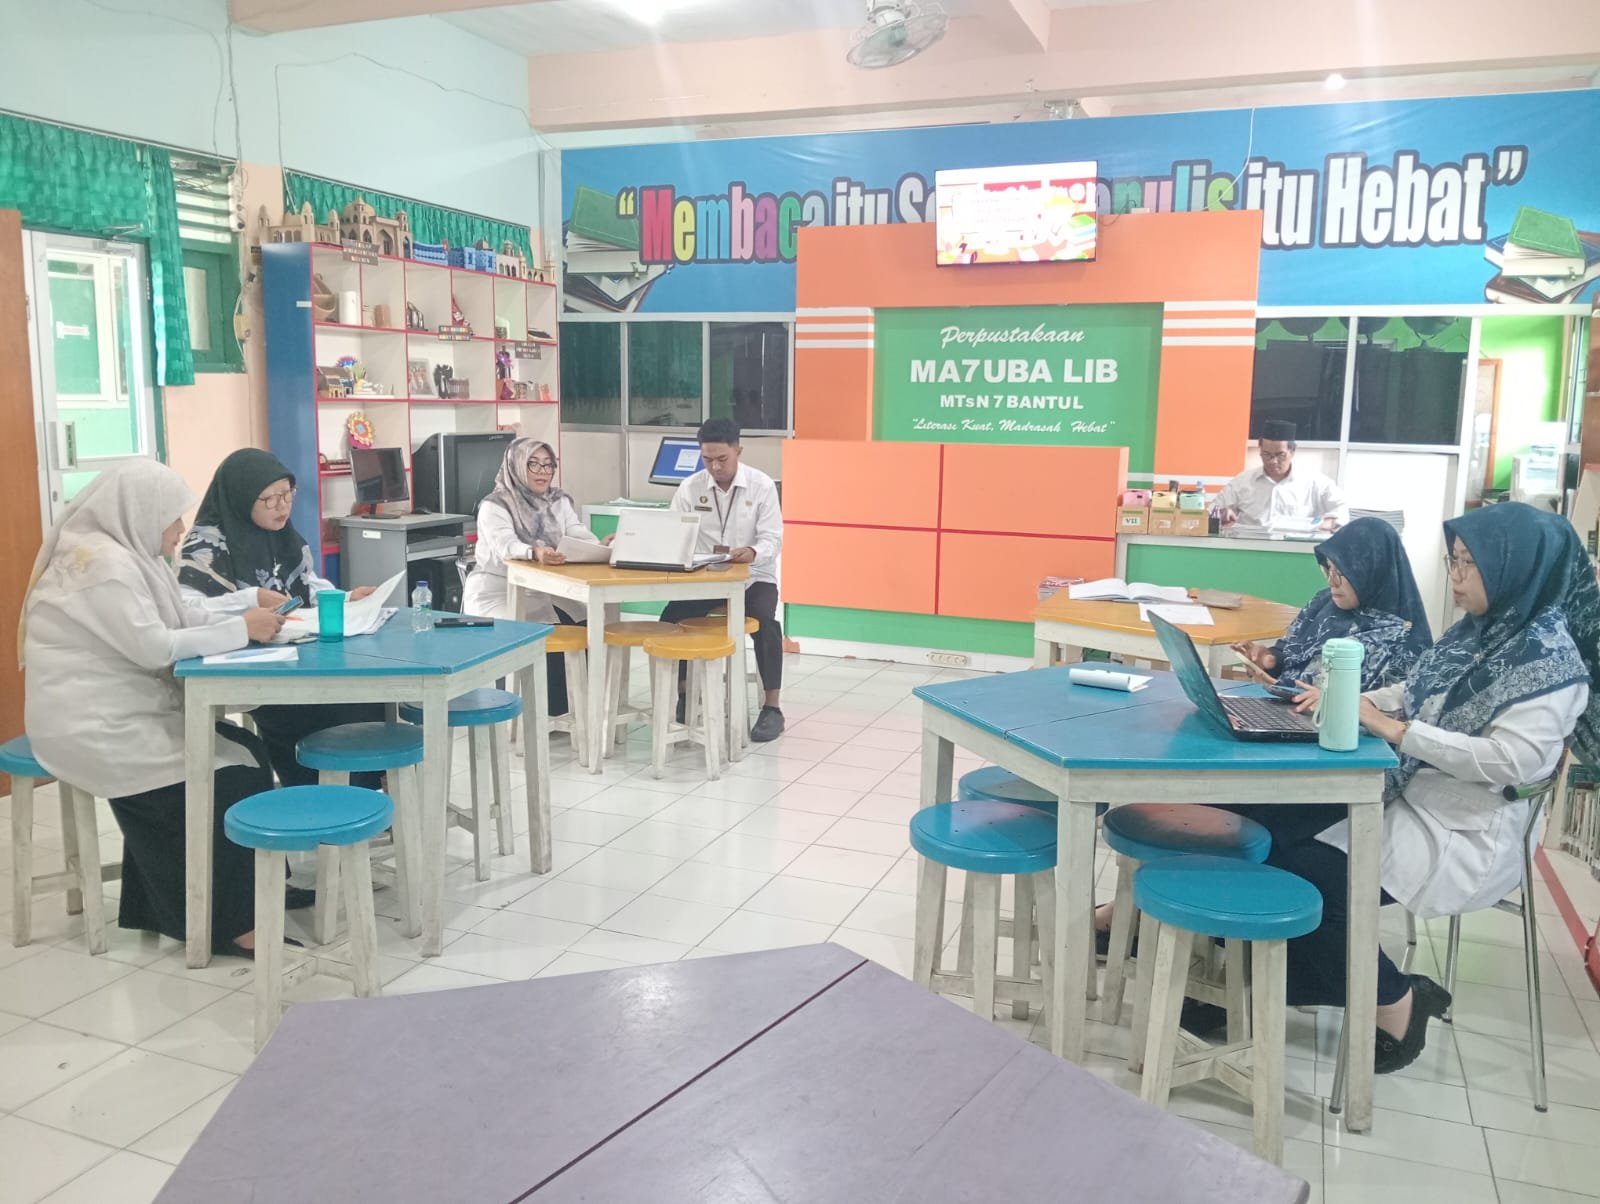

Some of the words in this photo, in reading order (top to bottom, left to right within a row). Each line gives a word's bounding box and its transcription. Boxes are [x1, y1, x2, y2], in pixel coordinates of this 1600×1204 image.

[1246, 160, 1315, 246] itu
[940, 322, 1085, 349] Perpustakaan
[910, 358, 1053, 383] MA7UBA
[1063, 358, 1118, 383] LIB
[940, 394, 989, 408] MTsN
[993, 395, 1004, 409] 7
[1006, 395, 1084, 410] BANTUL
[998, 419, 1062, 433] Madrasah
